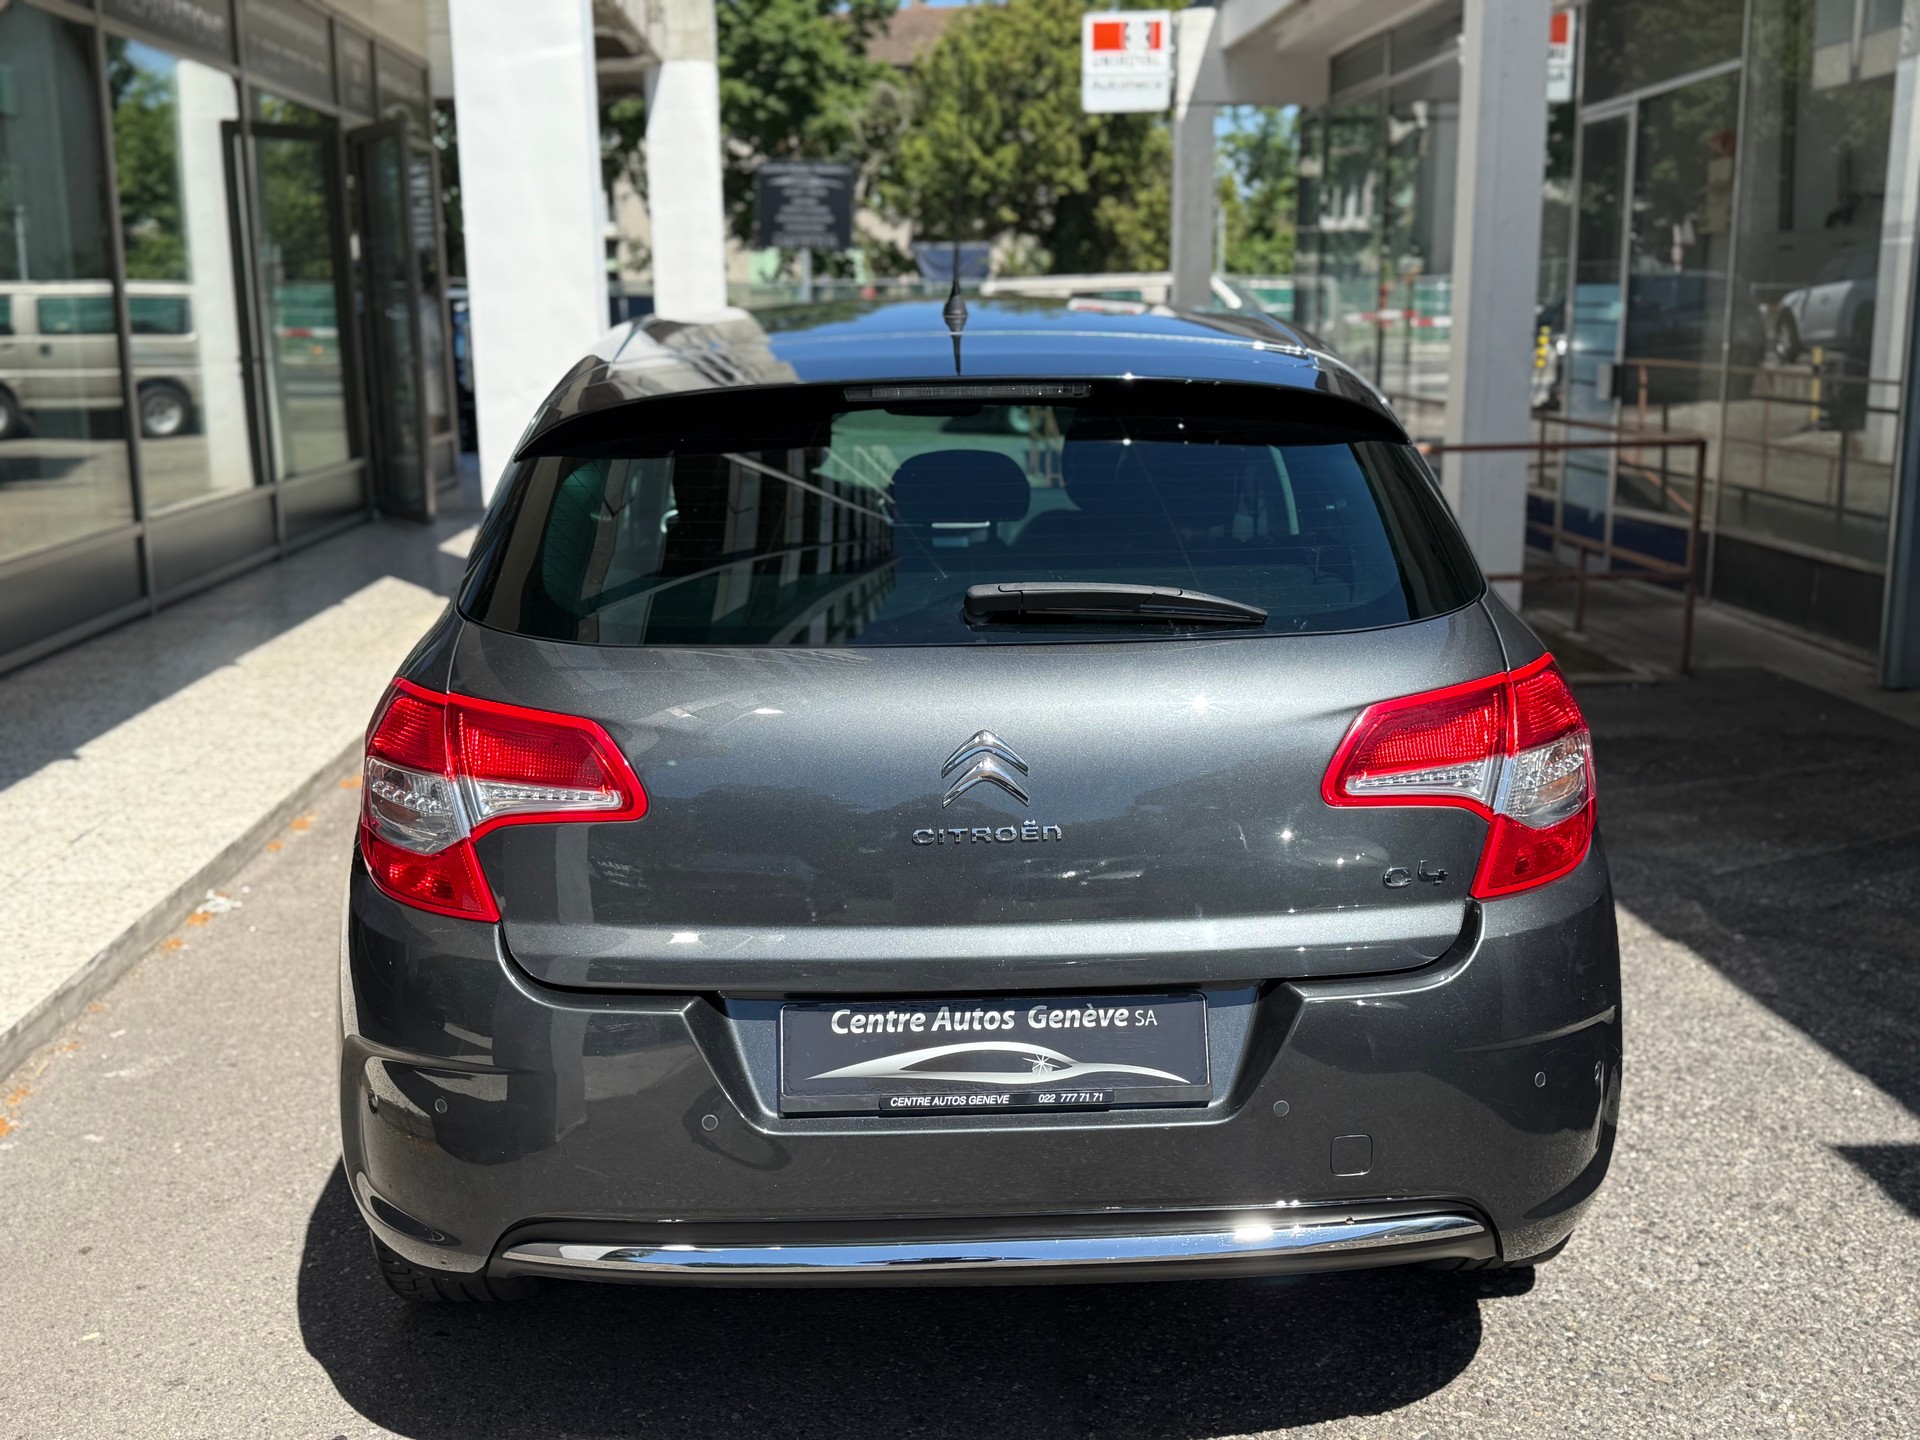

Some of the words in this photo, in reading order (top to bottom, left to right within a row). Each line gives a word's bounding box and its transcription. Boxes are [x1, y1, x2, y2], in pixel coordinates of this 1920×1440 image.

[1383, 860, 1449, 889] C4
[831, 1008, 925, 1035] Centre
[931, 1007, 1016, 1033] Autos
[1027, 1003, 1129, 1030] Genève
[1134, 1008, 1158, 1027] SA
[890, 1096, 932, 1107] CENTRE
[932, 1096, 966, 1106] AUTOS
[968, 1095, 1010, 1106] GENEVE
[1038, 1094, 1056, 1104] 022
[1060, 1093, 1077, 1104] 777
[1078, 1093, 1089, 1103] 71
[1091, 1093, 1104, 1103] 71
